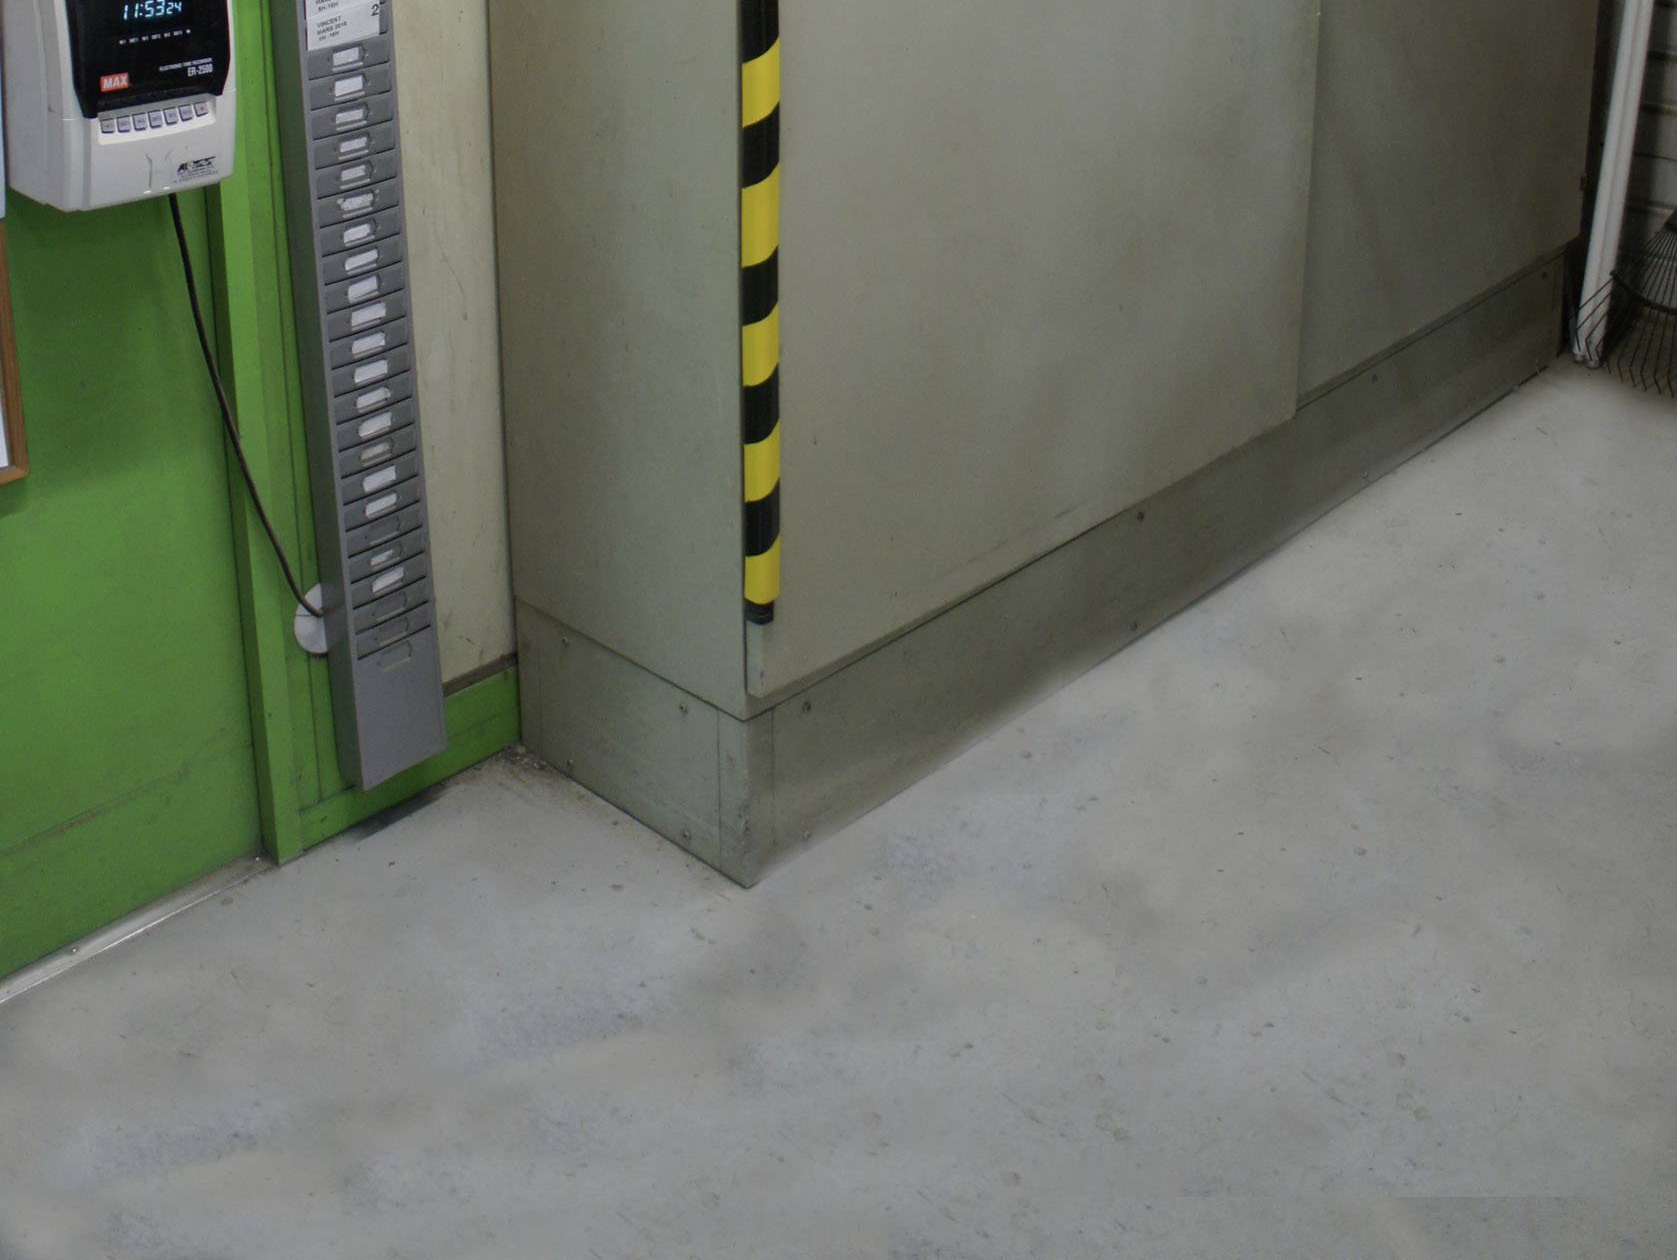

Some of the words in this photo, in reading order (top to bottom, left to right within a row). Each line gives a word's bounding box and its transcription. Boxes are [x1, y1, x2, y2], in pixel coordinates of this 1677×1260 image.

[166, 2, 182, 14] 24
[371, 4, 379, 16] 2
[103, 74, 128, 89] MAX
